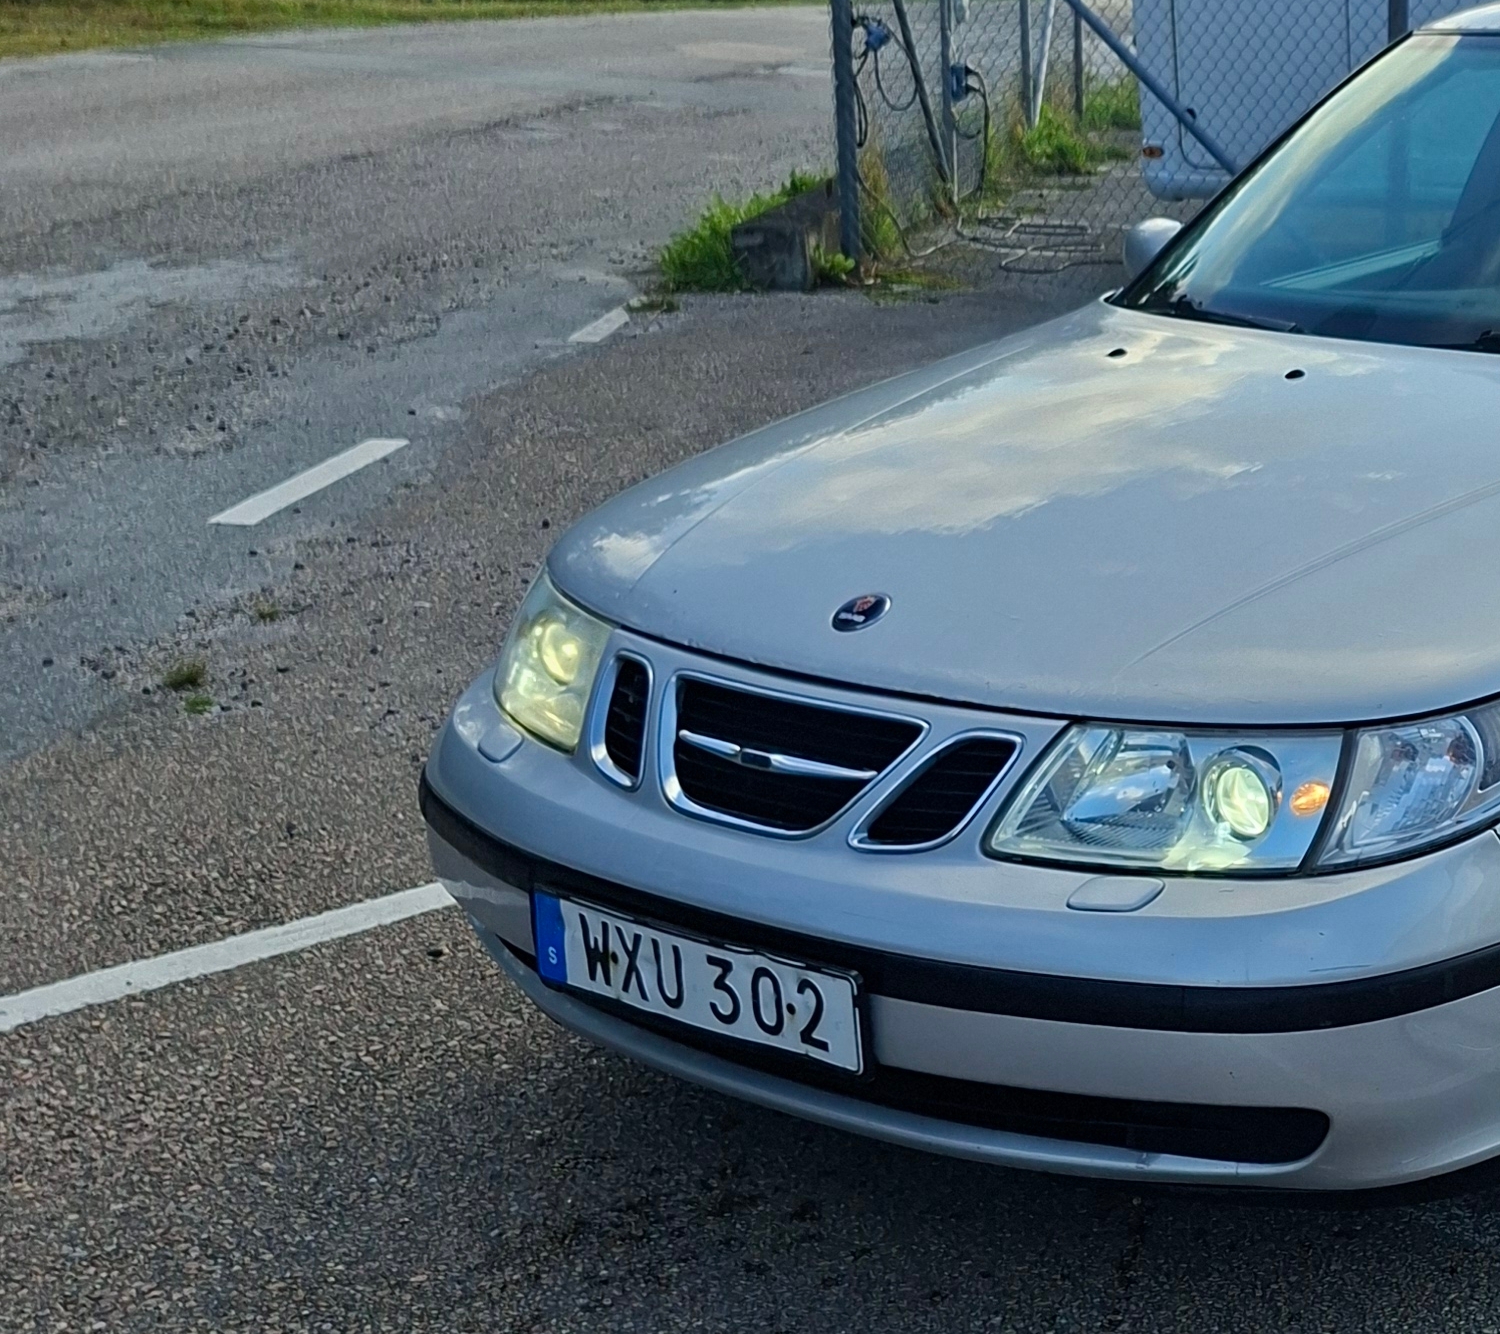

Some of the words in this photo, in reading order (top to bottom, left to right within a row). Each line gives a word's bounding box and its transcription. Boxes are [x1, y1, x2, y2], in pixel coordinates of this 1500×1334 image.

[547, 946, 558, 965] S
[578, 912, 685, 1009] WXU
[706, 954, 830, 1053] 302
